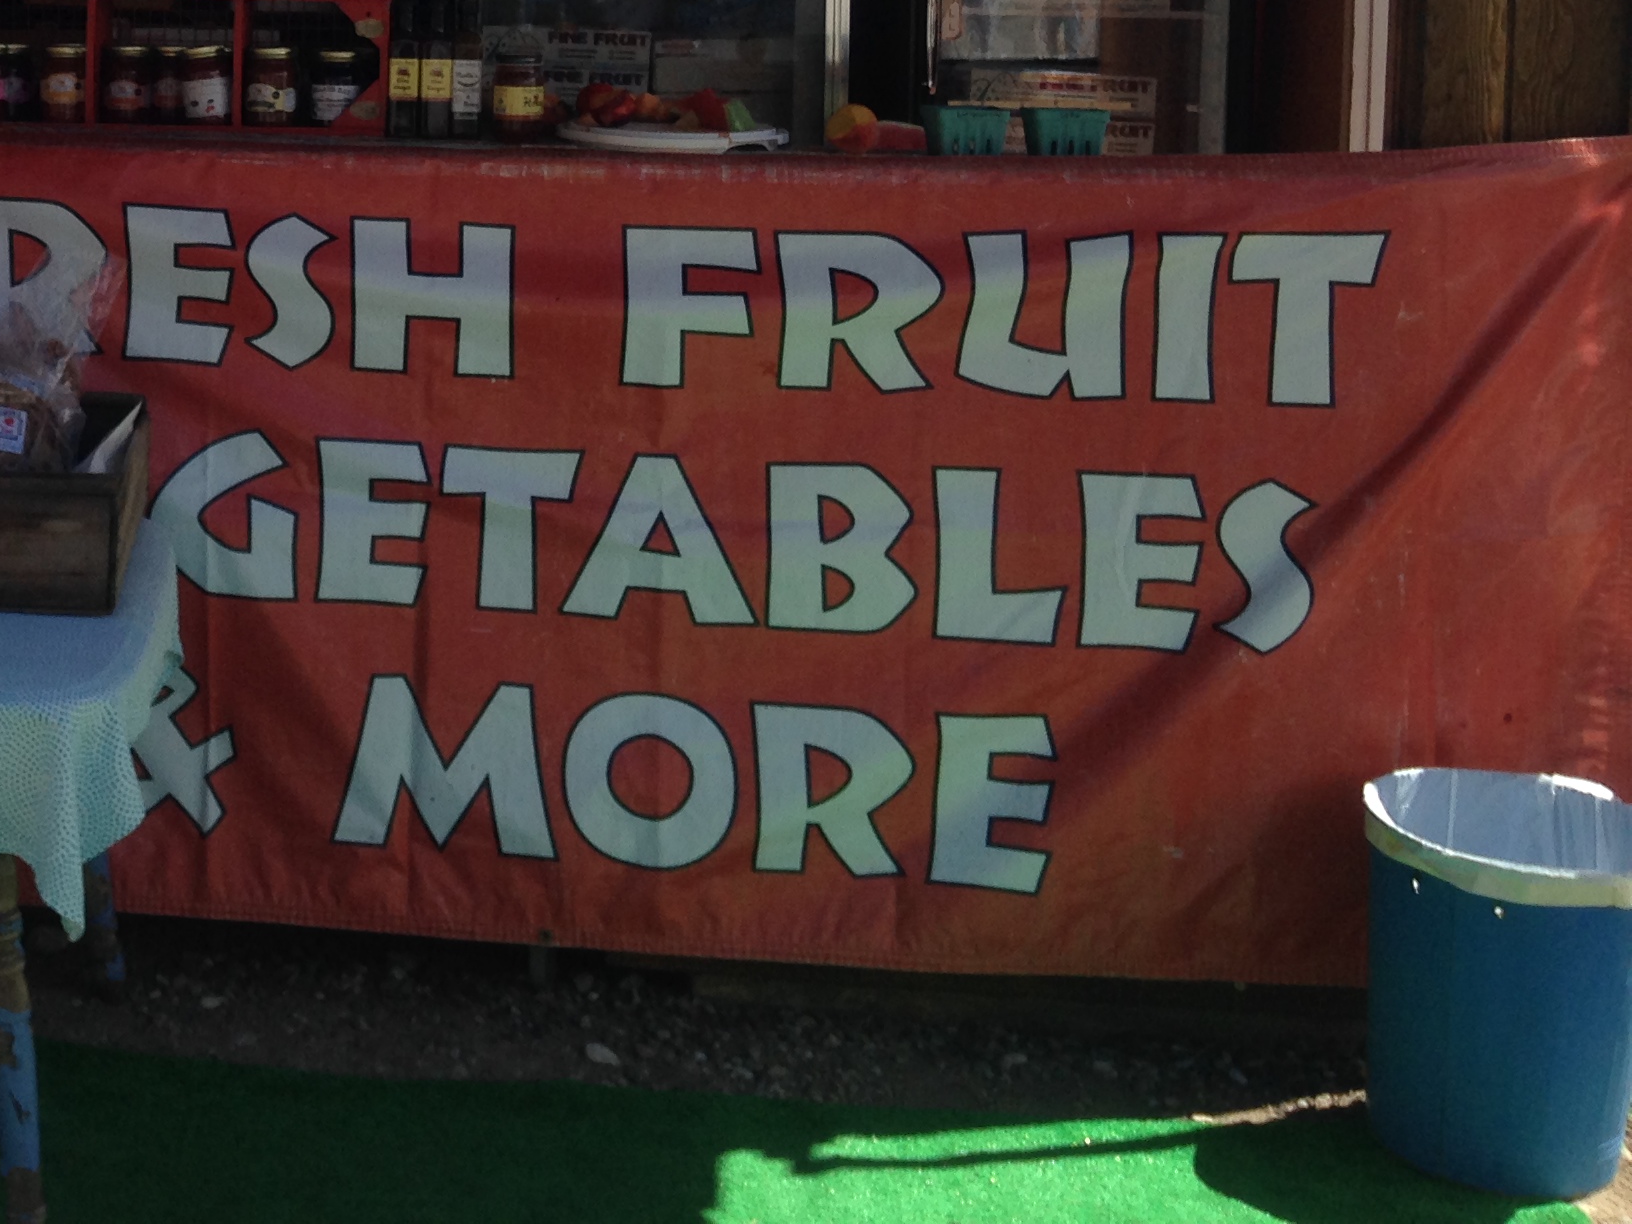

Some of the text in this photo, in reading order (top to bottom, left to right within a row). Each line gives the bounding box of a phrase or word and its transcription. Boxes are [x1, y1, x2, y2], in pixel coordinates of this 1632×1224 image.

[593, 32, 648, 46] FRUIT
[618, 223, 1391, 408] FRUIT
[150, 429, 1319, 655] GETABLES
[331, 673, 1057, 896] MORE
